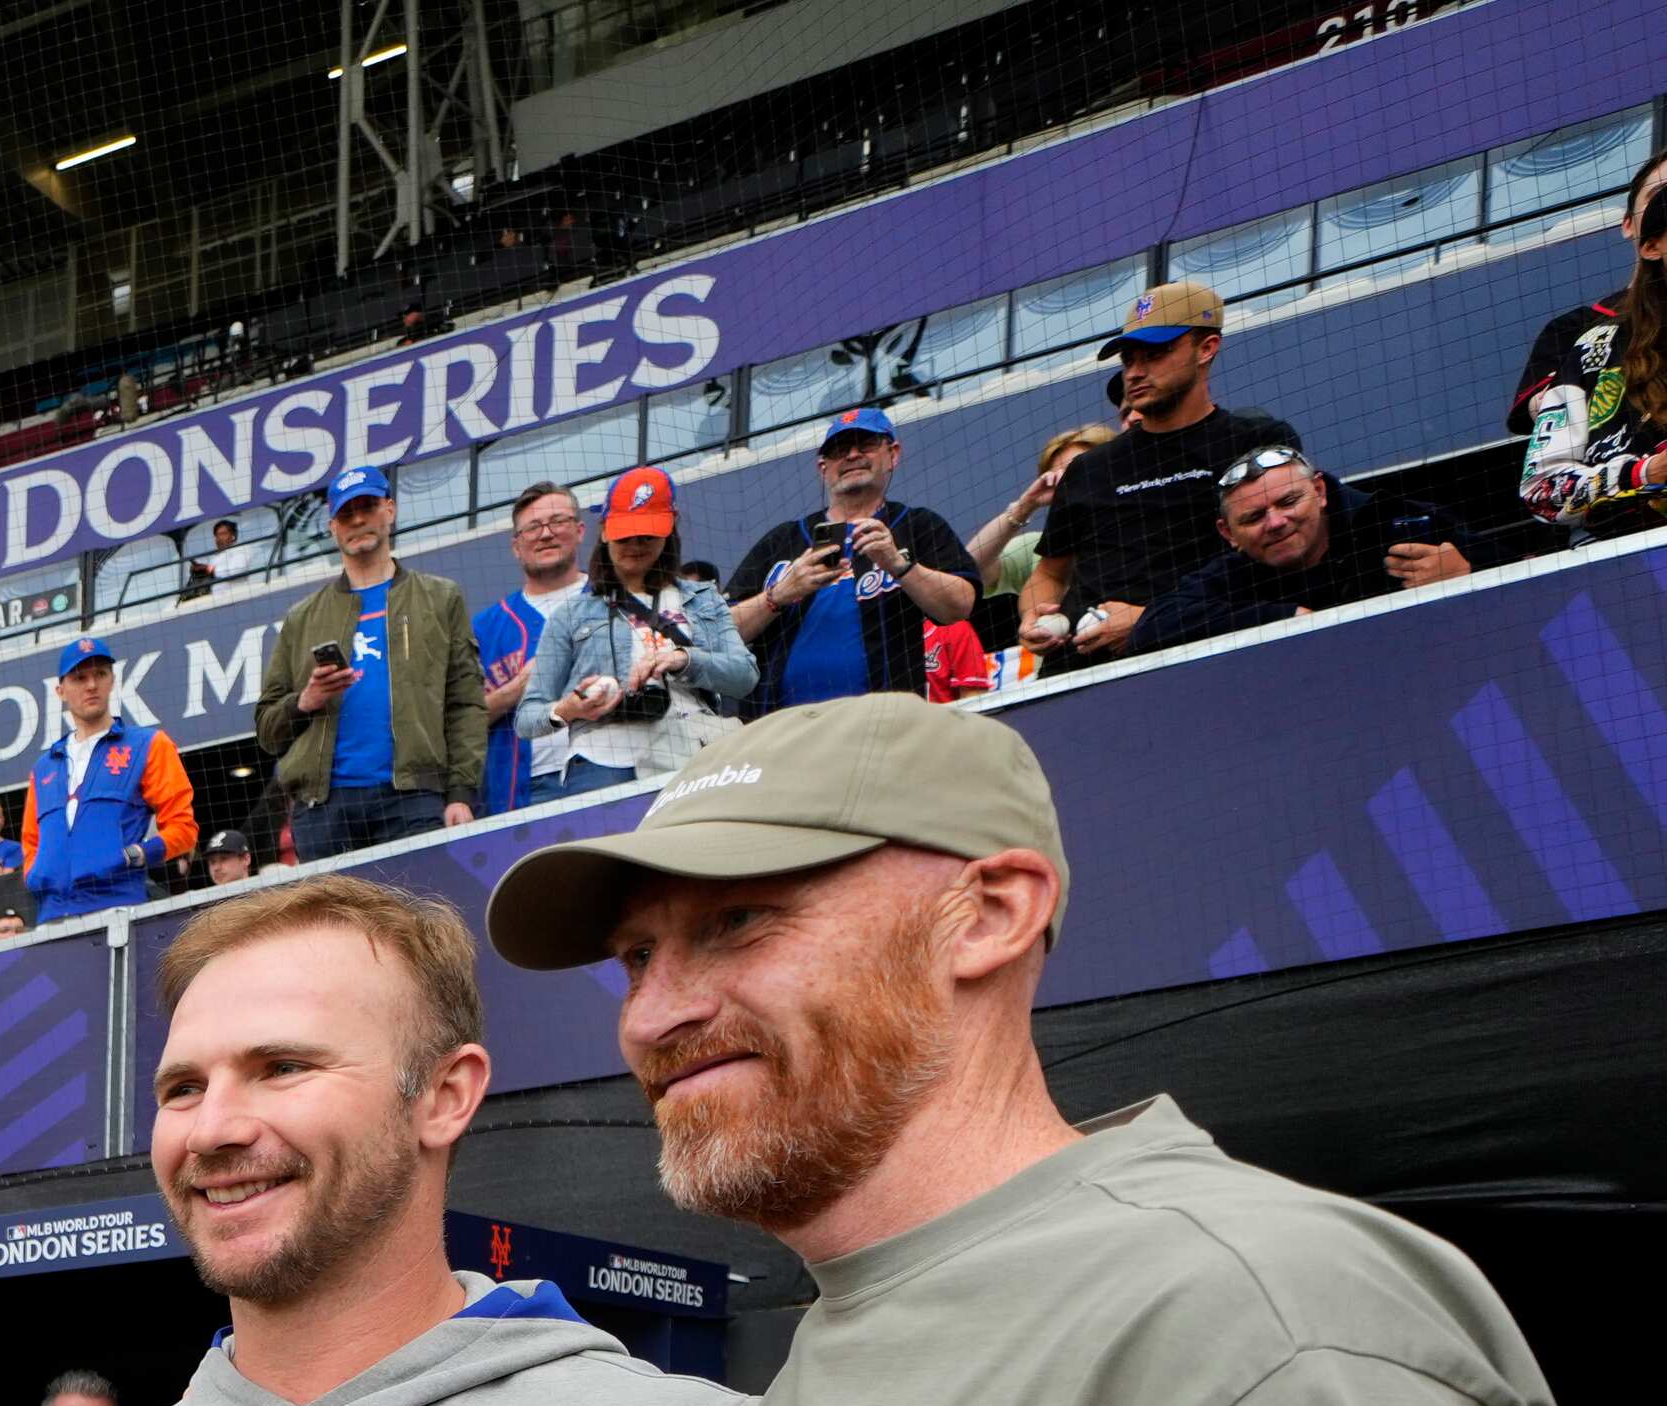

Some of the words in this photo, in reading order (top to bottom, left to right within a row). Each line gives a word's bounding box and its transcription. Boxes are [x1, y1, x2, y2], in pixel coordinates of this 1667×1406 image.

[27, 1222, 52, 1238] MLB
[52, 1215, 99, 1233] WORLD
[99, 1211, 133, 1227] TOUR
[81, 1223, 167, 1257] SERIES
[623, 1258, 641, 1272] MLB
[640, 1261, 668, 1277] WORLD
[667, 1267, 688, 1281] TOUR
[588, 1265, 654, 1299] LONDON
[655, 1278, 704, 1308] SERIES
